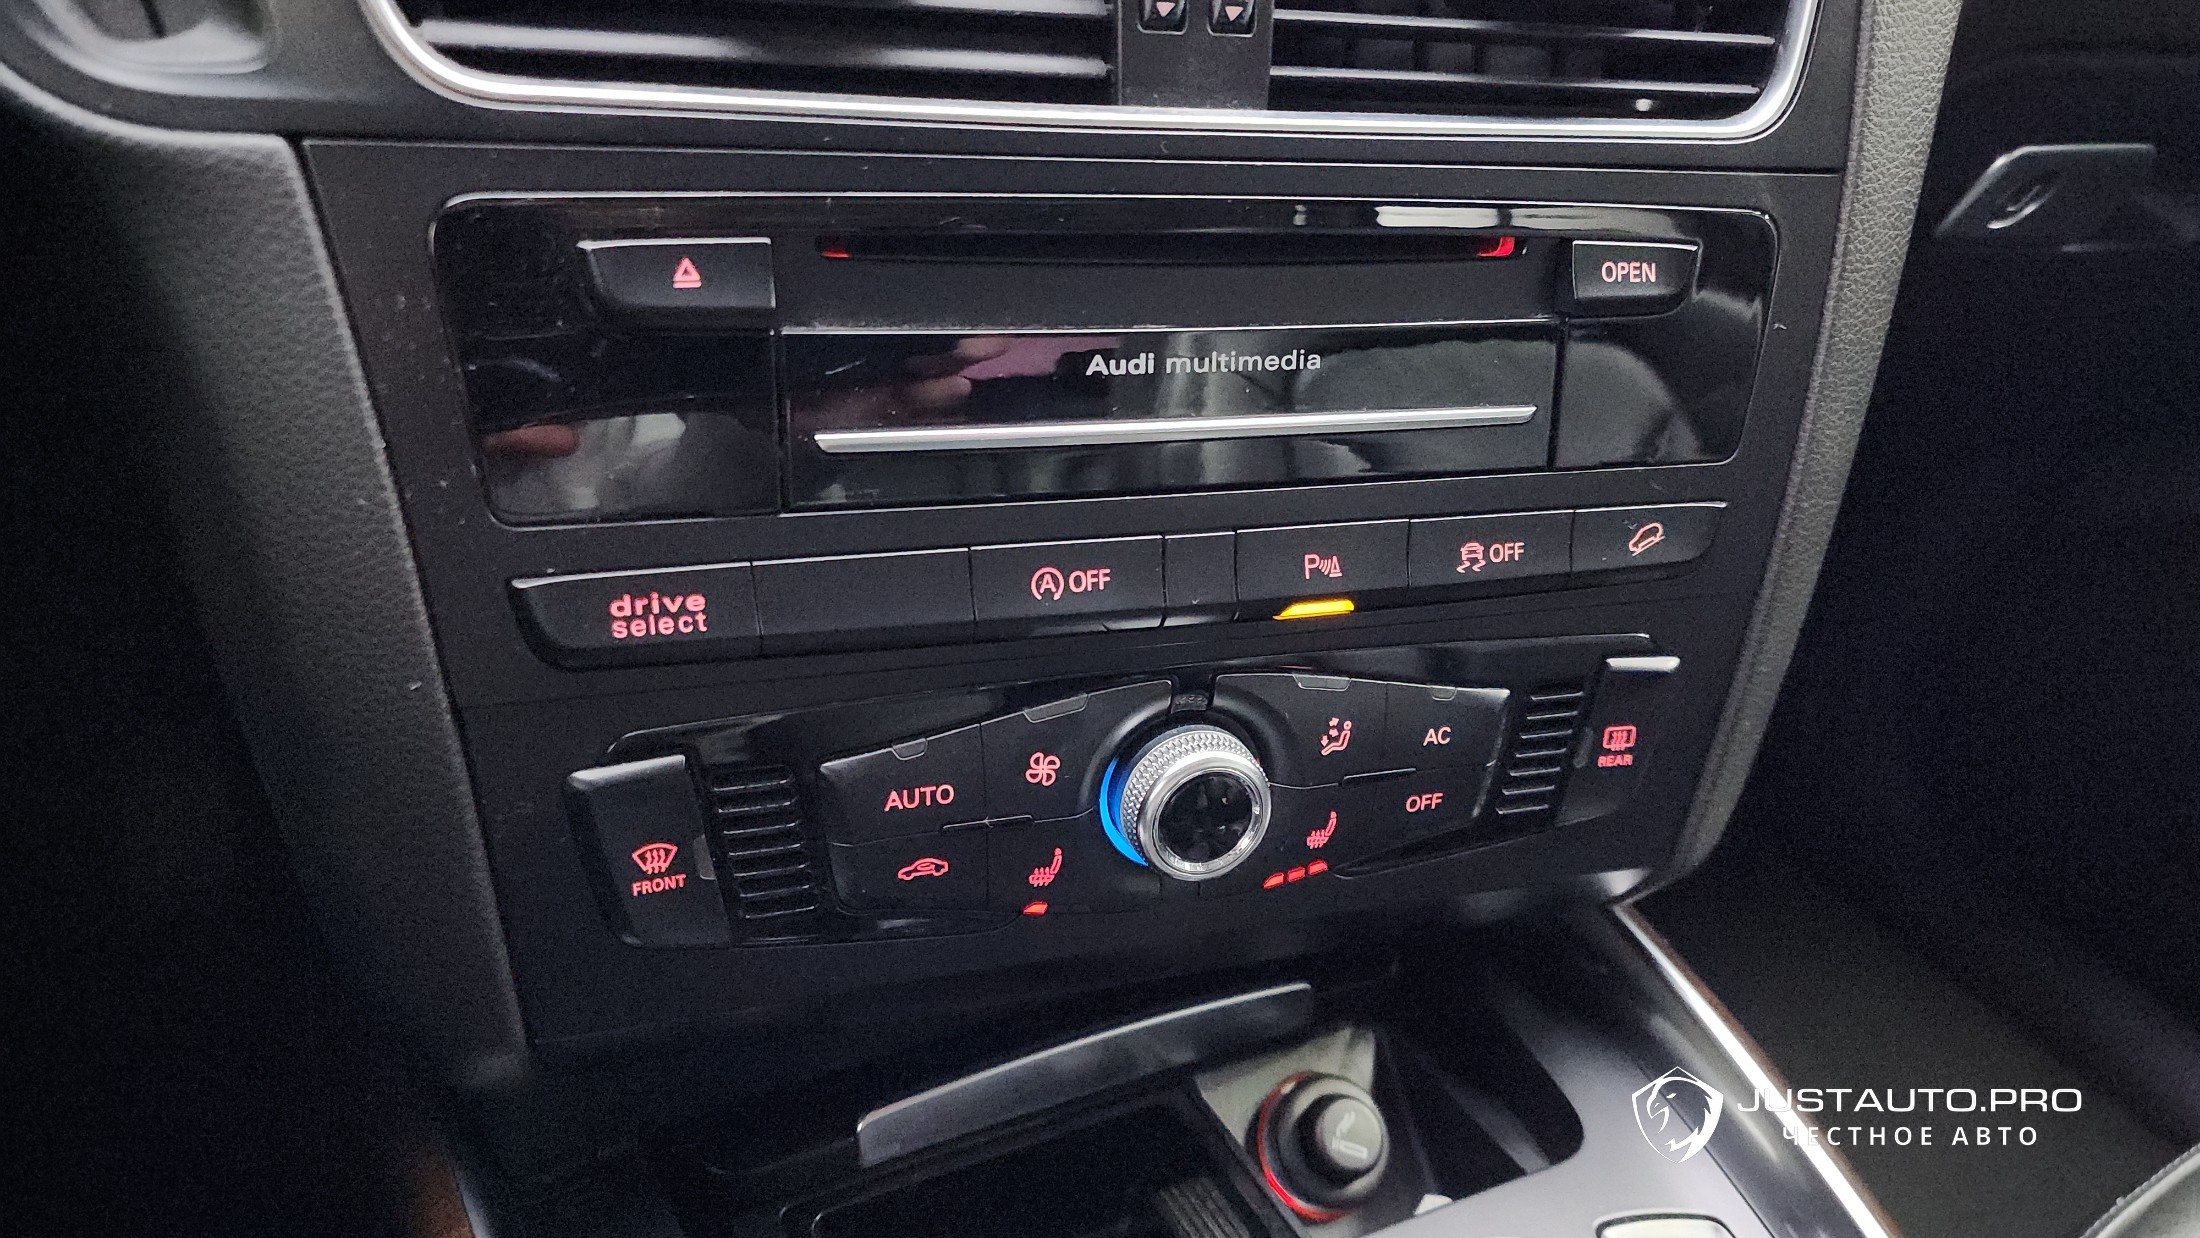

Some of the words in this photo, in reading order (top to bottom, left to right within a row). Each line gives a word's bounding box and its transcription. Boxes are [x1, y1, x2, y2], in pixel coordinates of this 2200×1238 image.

[1600, 260, 1657, 286] OPEN
[1085, 349, 1155, 376] Audi
[1165, 348, 1322, 374] multimedia
[1489, 542, 1525, 562] OFF
[1068, 568, 1111, 593] OFF
[609, 590, 707, 618] drive
[611, 612, 708, 638] select
[1422, 725, 1452, 747] AC
[1597, 754, 1634, 768] REAR
[884, 785, 954, 811] AUTO
[1405, 792, 1444, 813] OFF
[631, 873, 687, 897] FRONT
